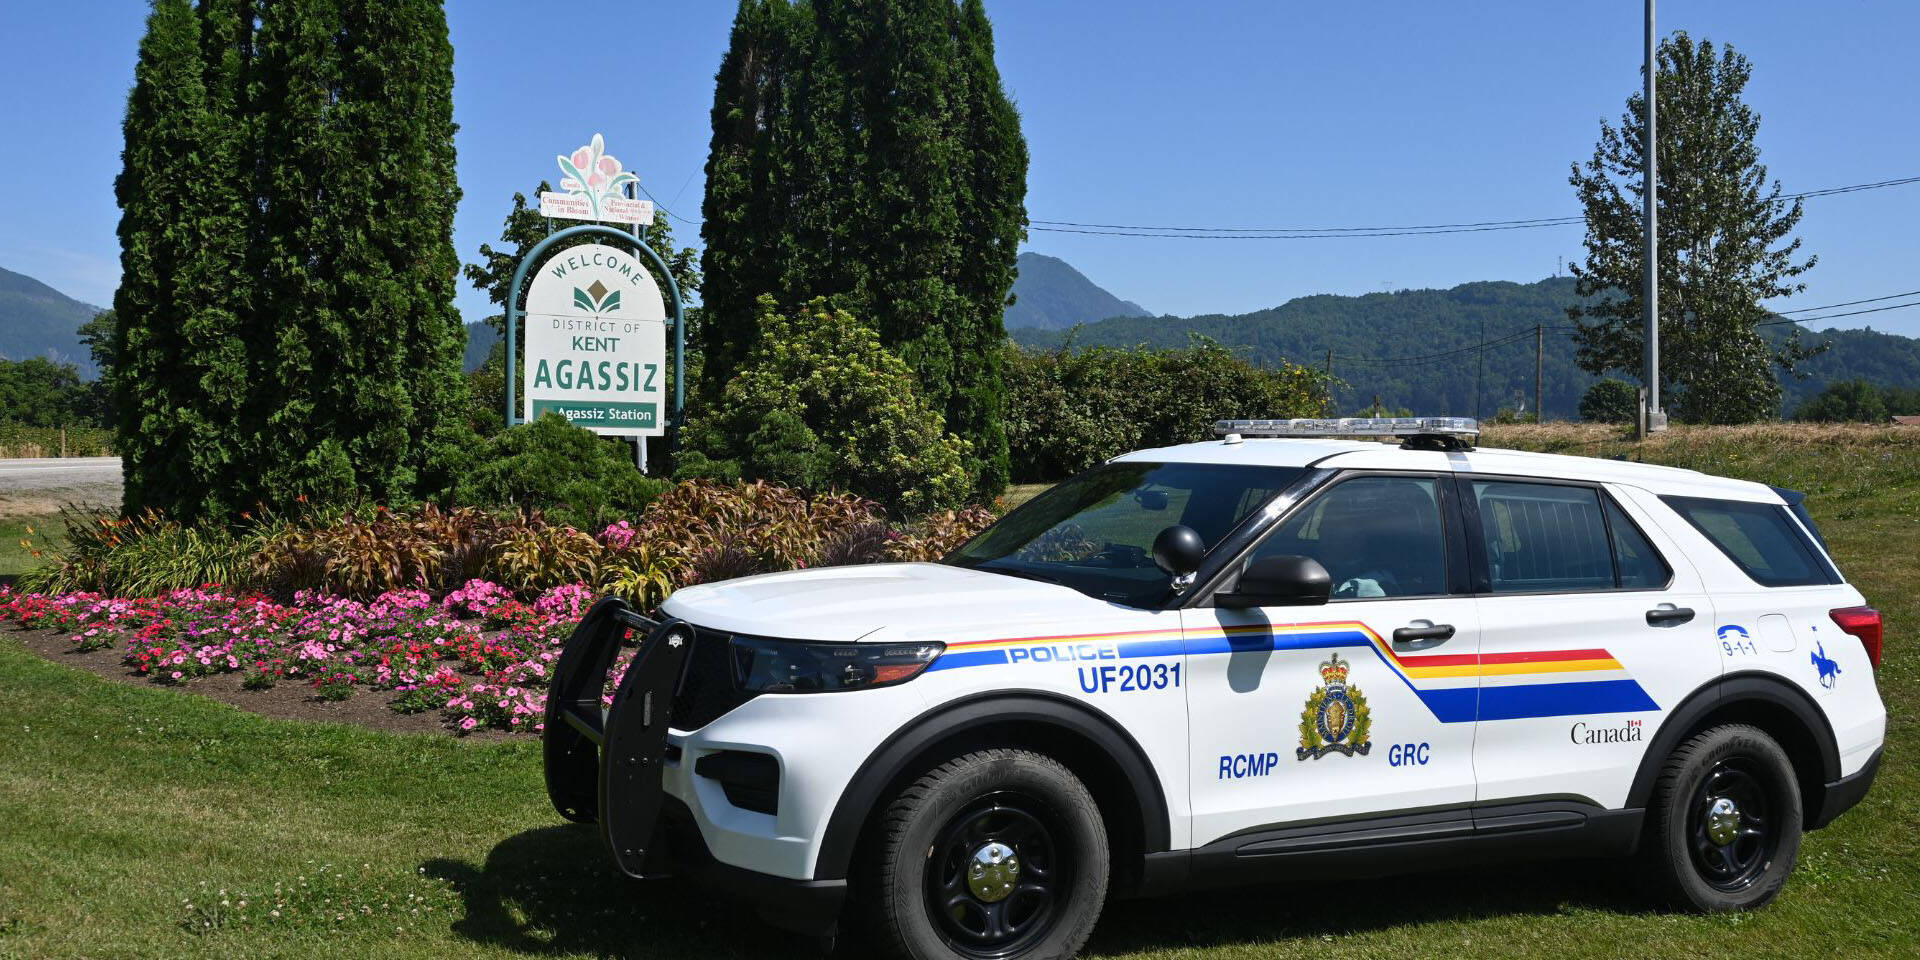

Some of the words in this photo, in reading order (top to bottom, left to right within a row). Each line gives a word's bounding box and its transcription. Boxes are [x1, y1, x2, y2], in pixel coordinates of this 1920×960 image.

[551, 253, 644, 286] WELCOME
[552, 319, 616, 331] DISTRICT
[624, 323, 641, 333] OF
[572, 336, 621, 353] KENT
[533, 359, 658, 393] AGASSIZ
[557, 407, 605, 421] Agassiz
[609, 408, 651, 421] Station
[1008, 643, 1116, 664] POLICE
[1722, 641, 1758, 657] 9-1-1
[1078, 662, 1181, 694] UF2031
[1570, 720, 1642, 746] Canada
[1218, 752, 1279, 780] RCMP
[1388, 742, 1430, 767] GRC
